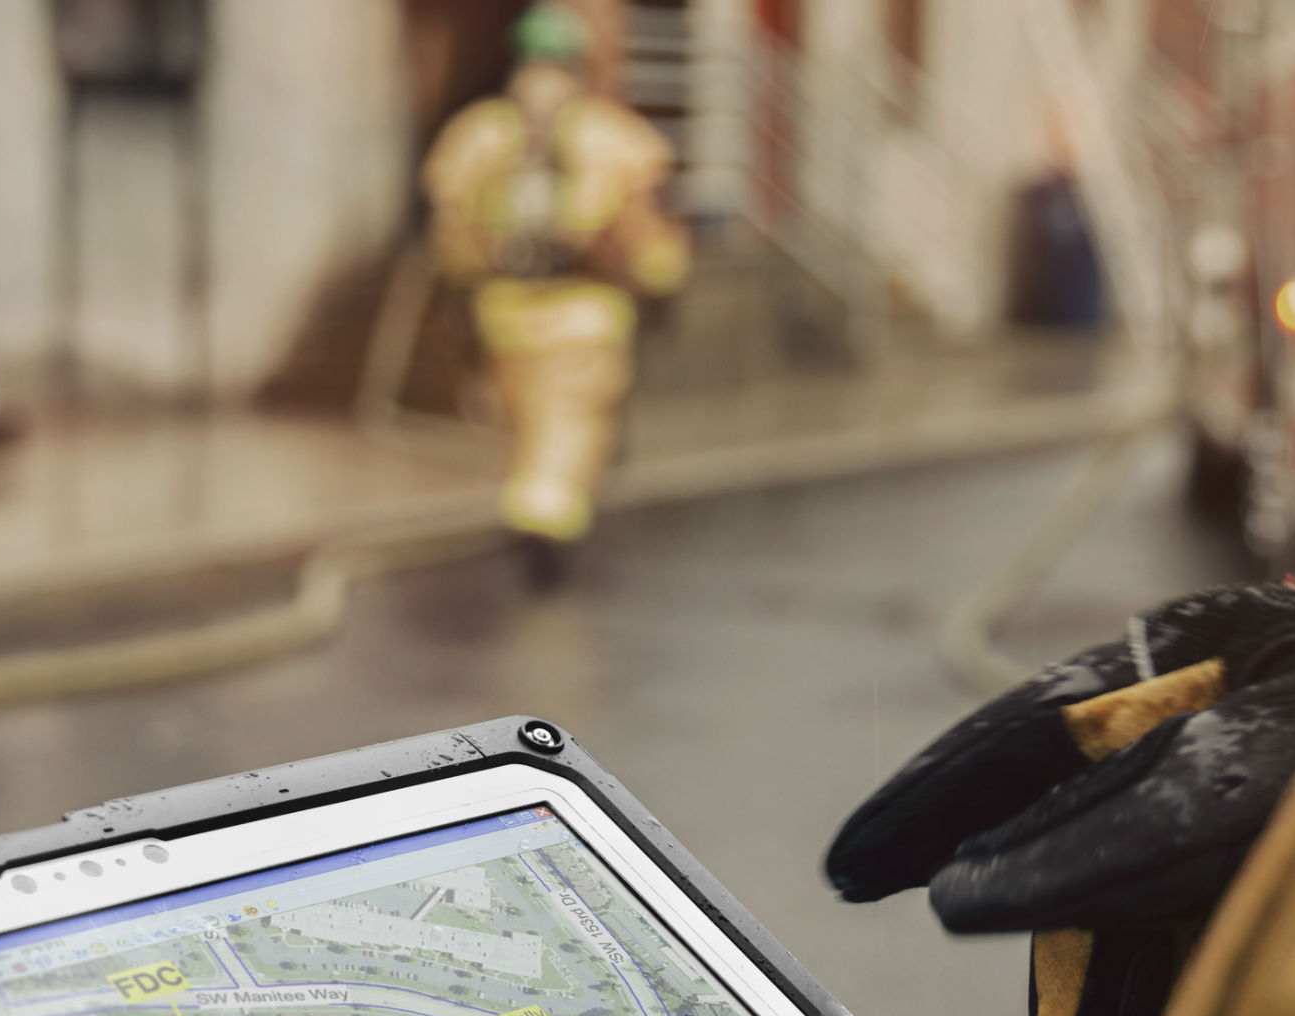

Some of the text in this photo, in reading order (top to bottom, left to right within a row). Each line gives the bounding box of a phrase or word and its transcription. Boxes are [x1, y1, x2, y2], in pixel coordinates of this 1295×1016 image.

[570, 907, 603, 938] 153rd
[598, 942, 624, 964] SW
[113, 965, 183, 998] FDC
[195, 988, 349, 1006] SW Manitee Way
